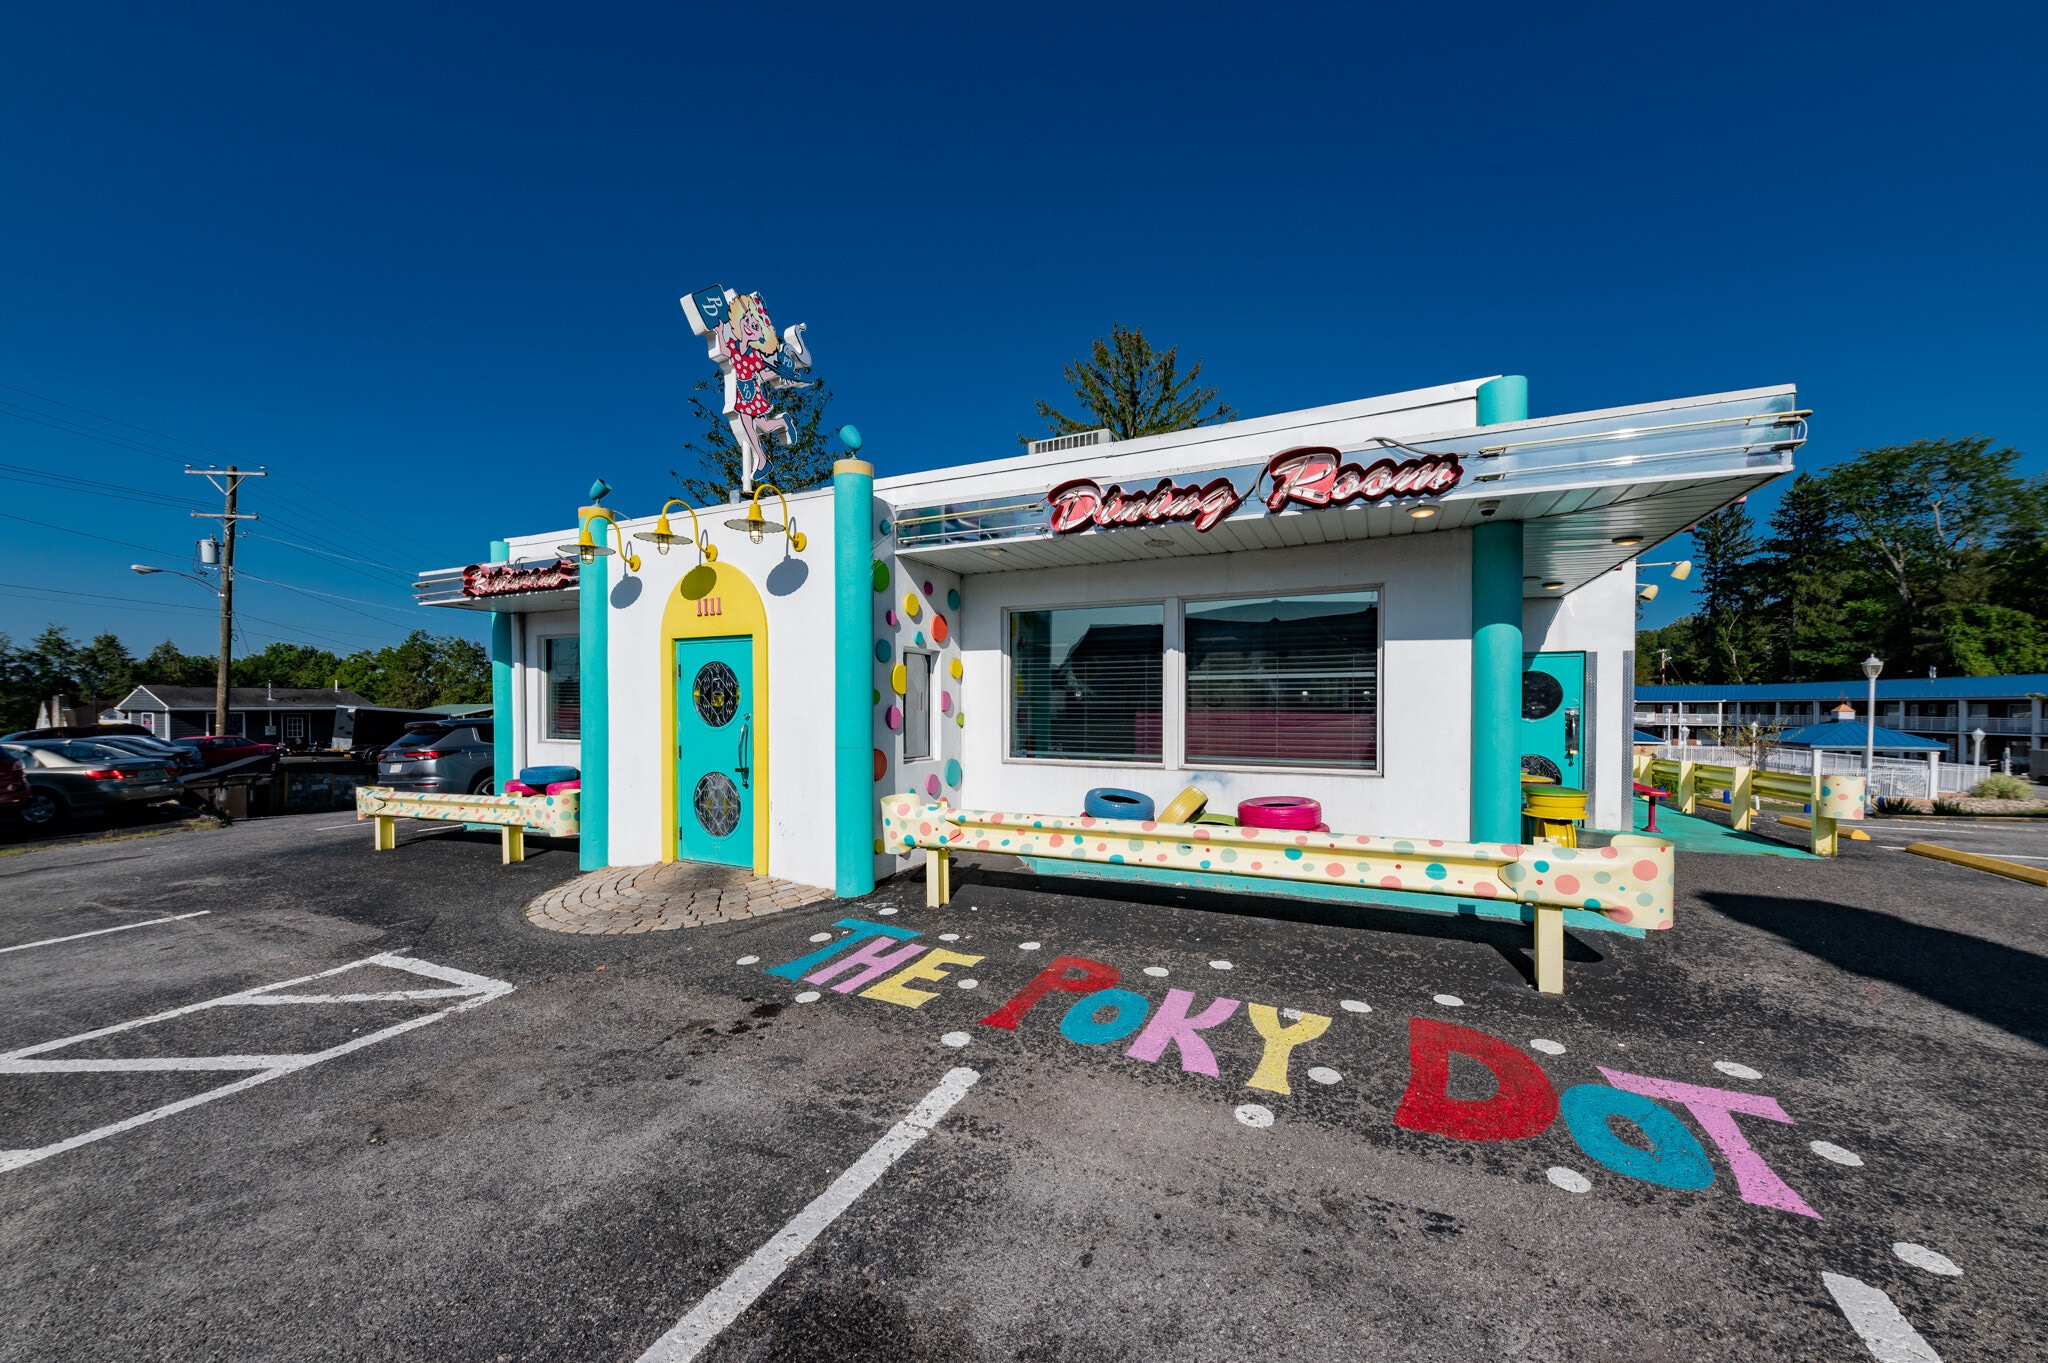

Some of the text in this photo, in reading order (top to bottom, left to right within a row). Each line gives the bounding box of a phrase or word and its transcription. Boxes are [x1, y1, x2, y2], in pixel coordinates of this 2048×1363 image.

[1048, 446, 1463, 533] Dining Room
[763, 918, 1824, 1219] THE POKY DOT
